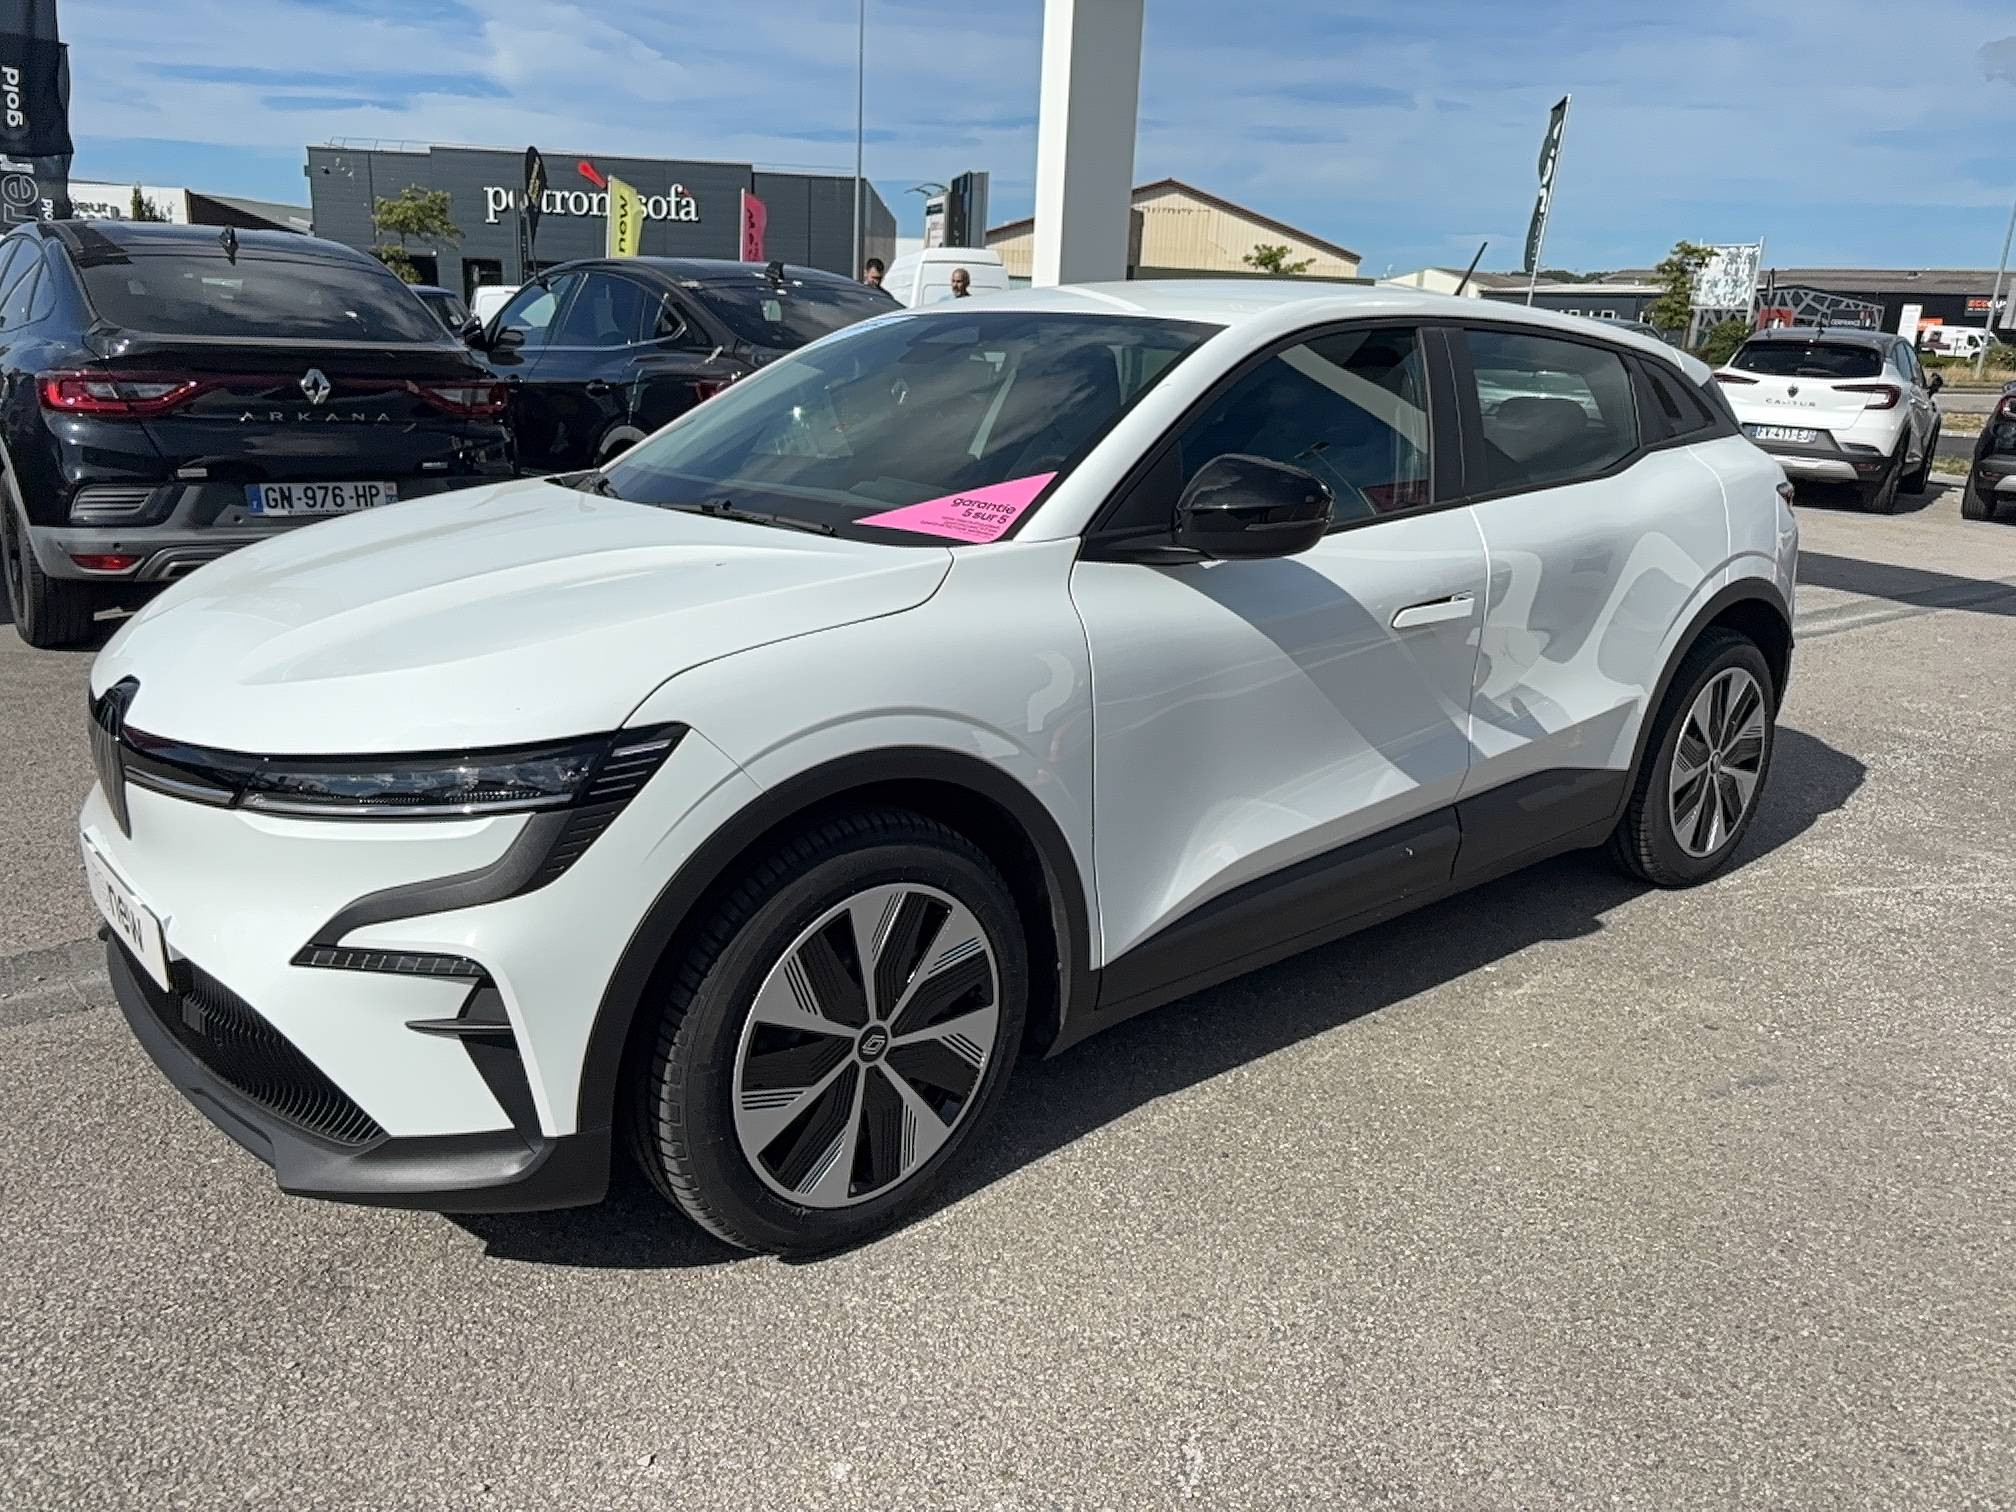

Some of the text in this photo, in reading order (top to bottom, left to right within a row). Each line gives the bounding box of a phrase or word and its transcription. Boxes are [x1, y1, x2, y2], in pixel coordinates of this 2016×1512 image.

[1, 65, 24, 128] gold
[484, 183, 699, 224] potronsofà
[239, 411, 391, 422] ARKANA
[264, 485, 380, 509] GN-976-HP
[950, 497, 1017, 515] garantie
[962, 508, 1011, 525] 5 sur 5
